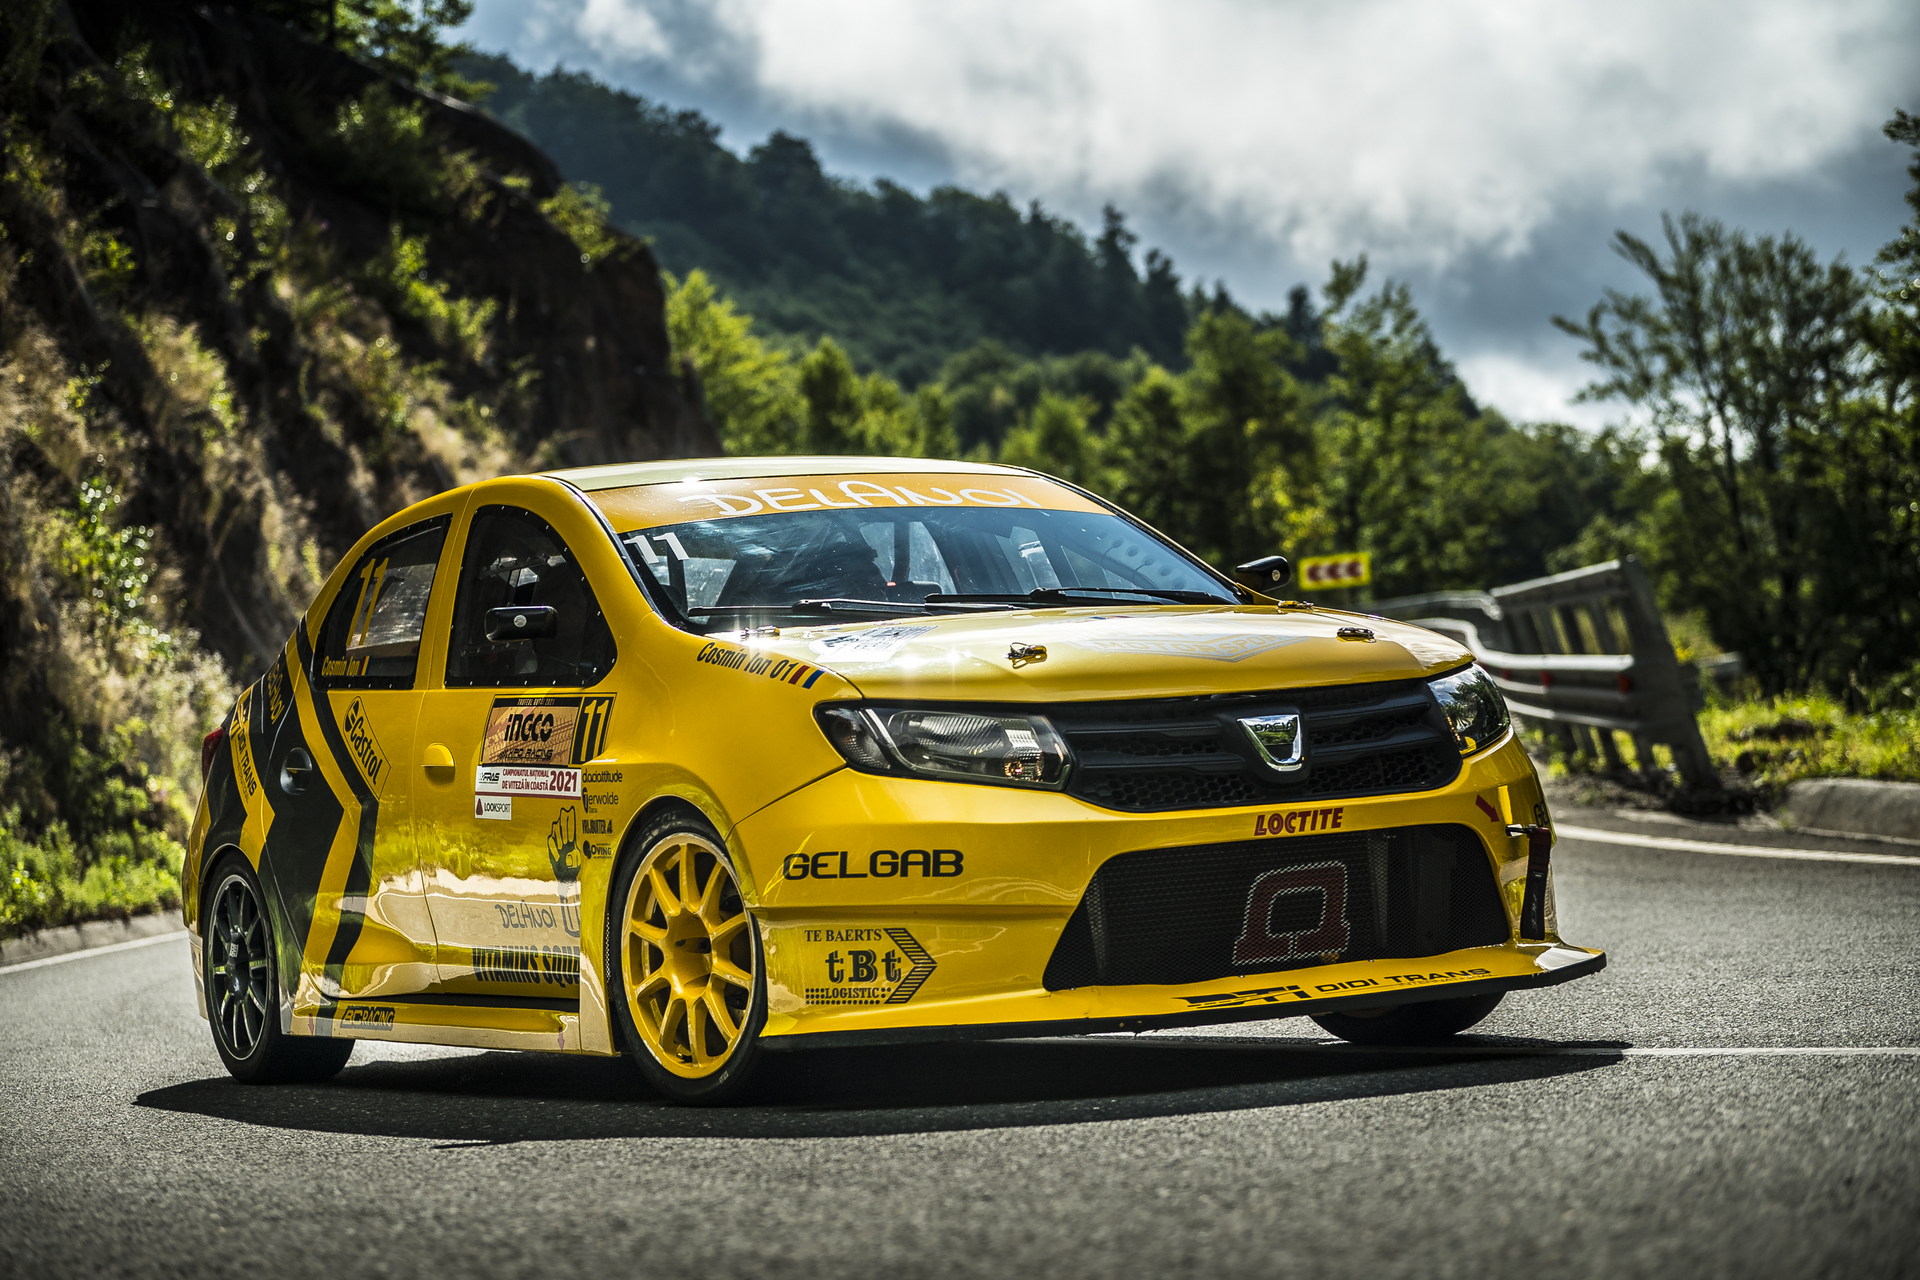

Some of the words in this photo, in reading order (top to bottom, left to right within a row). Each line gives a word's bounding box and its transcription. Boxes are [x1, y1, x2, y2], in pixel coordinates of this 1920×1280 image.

[623, 532, 690, 564] 11
[346, 557, 389, 646] 11
[322, 655, 347, 676] Cosmin
[347, 656, 360, 677] Ion
[697, 642, 747, 669] Cosmin
[743, 653, 773, 676] Ion
[769, 659, 799, 681] 01
[580, 699, 610, 762] 11
[1254, 721, 1294, 733] DACIA
[350, 716, 383, 785] Castrol
[240, 750, 257, 796] TRANS
[502, 768, 529, 777] CAMPIONATUL
[549, 770, 578, 792] 2021
[502, 781, 508, 789] DE
[525, 779, 530, 790] ÎN
[1254, 807, 1344, 836] LOCTITE
[783, 849, 964, 880] GELGAB
[805, 929, 822, 942] TE
[825, 929, 882, 942] BAERTS
[471, 945, 541, 984] VITAMINS
[824, 987, 880, 999] LOGISTIC
[1315, 978, 1379, 993] DIDI
[1384, 968, 1492, 985] TRANS
